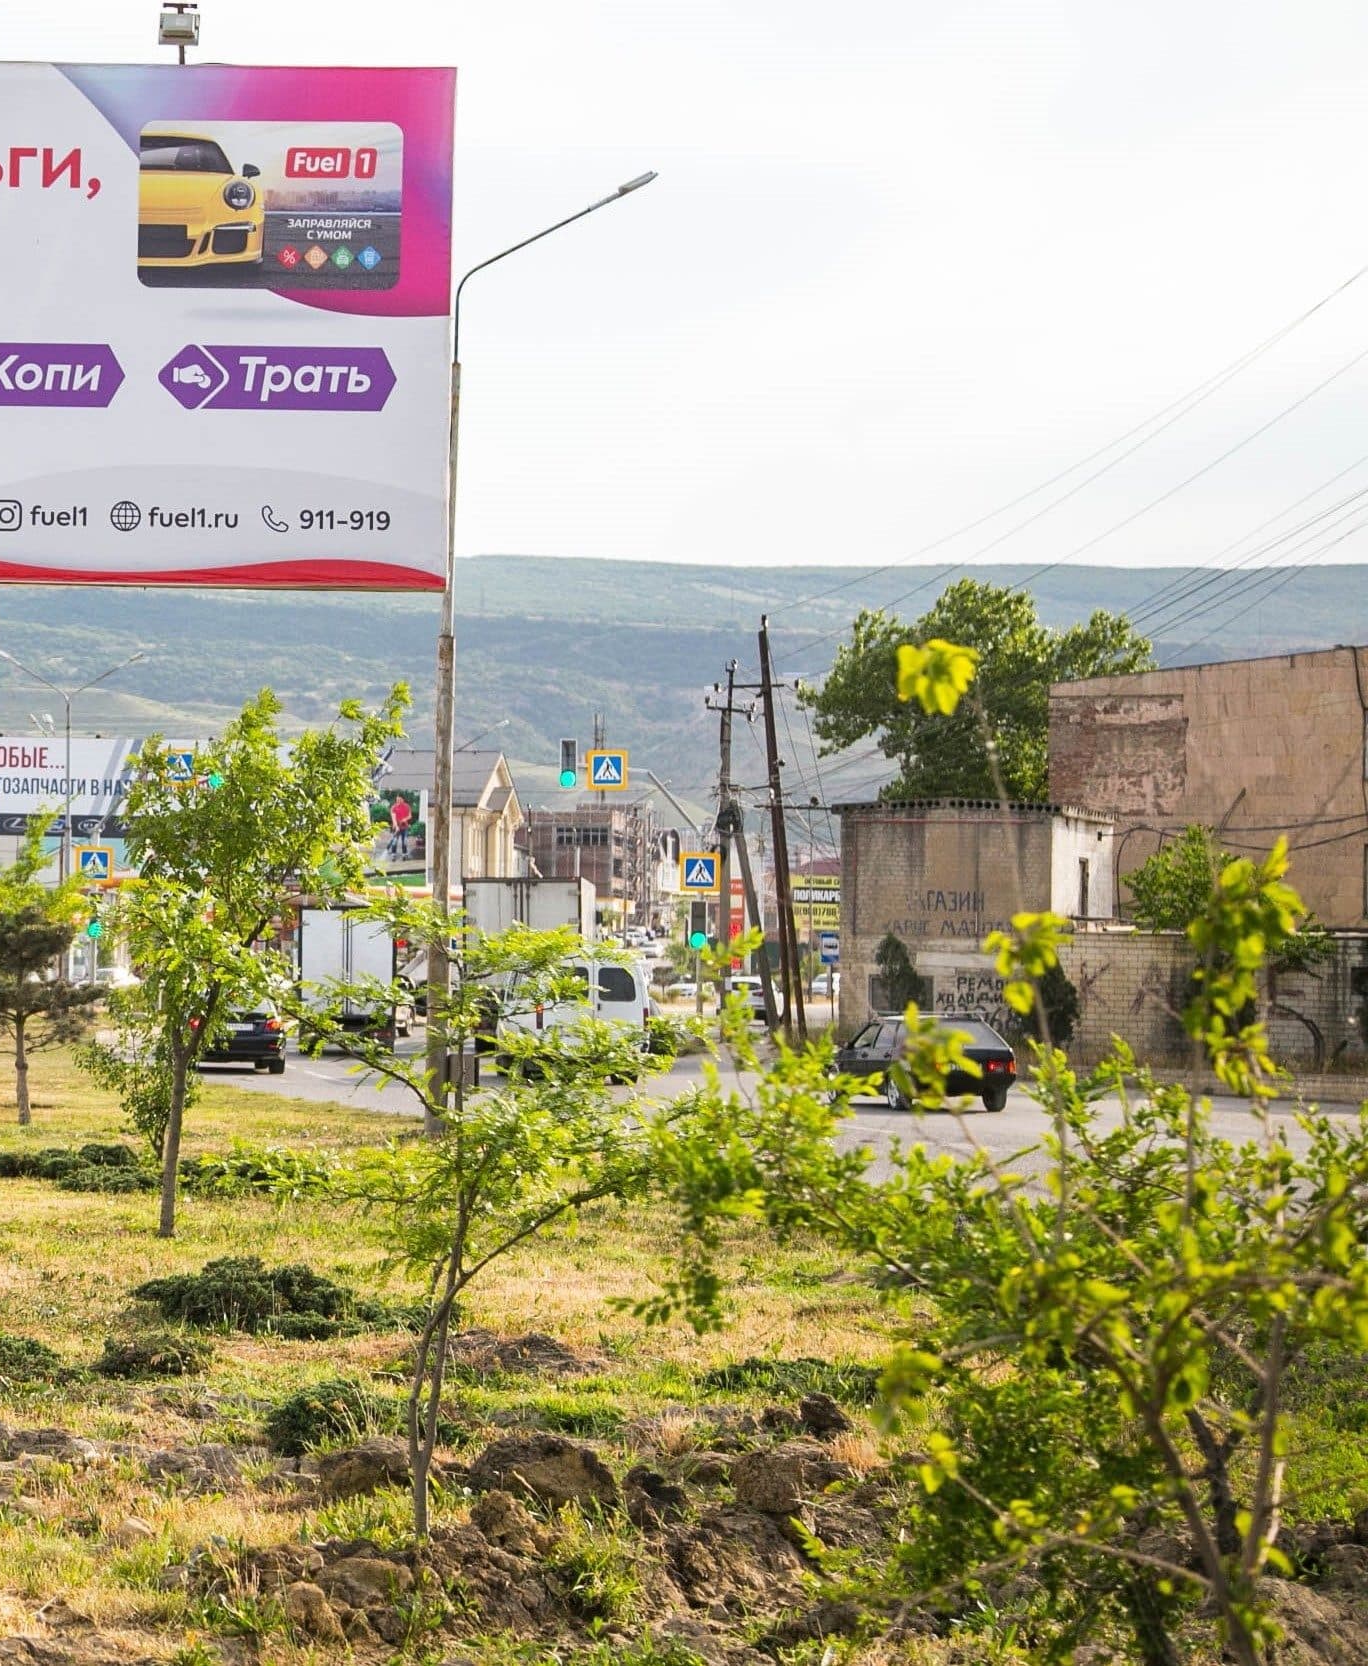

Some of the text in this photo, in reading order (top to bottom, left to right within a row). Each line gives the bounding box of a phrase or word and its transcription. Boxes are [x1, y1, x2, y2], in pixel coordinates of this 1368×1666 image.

[293, 152, 370, 173] Fuel 1
[287, 218, 372, 229] ЗАПРАВЛЯЙСЯ
[316, 230, 352, 239] УМОМ
[239, 356, 371, 402] Трать
[29, 504, 87, 527] fuel1
[148, 506, 239, 529] fuel1.ru
[299, 509, 391, 531] 911-919
